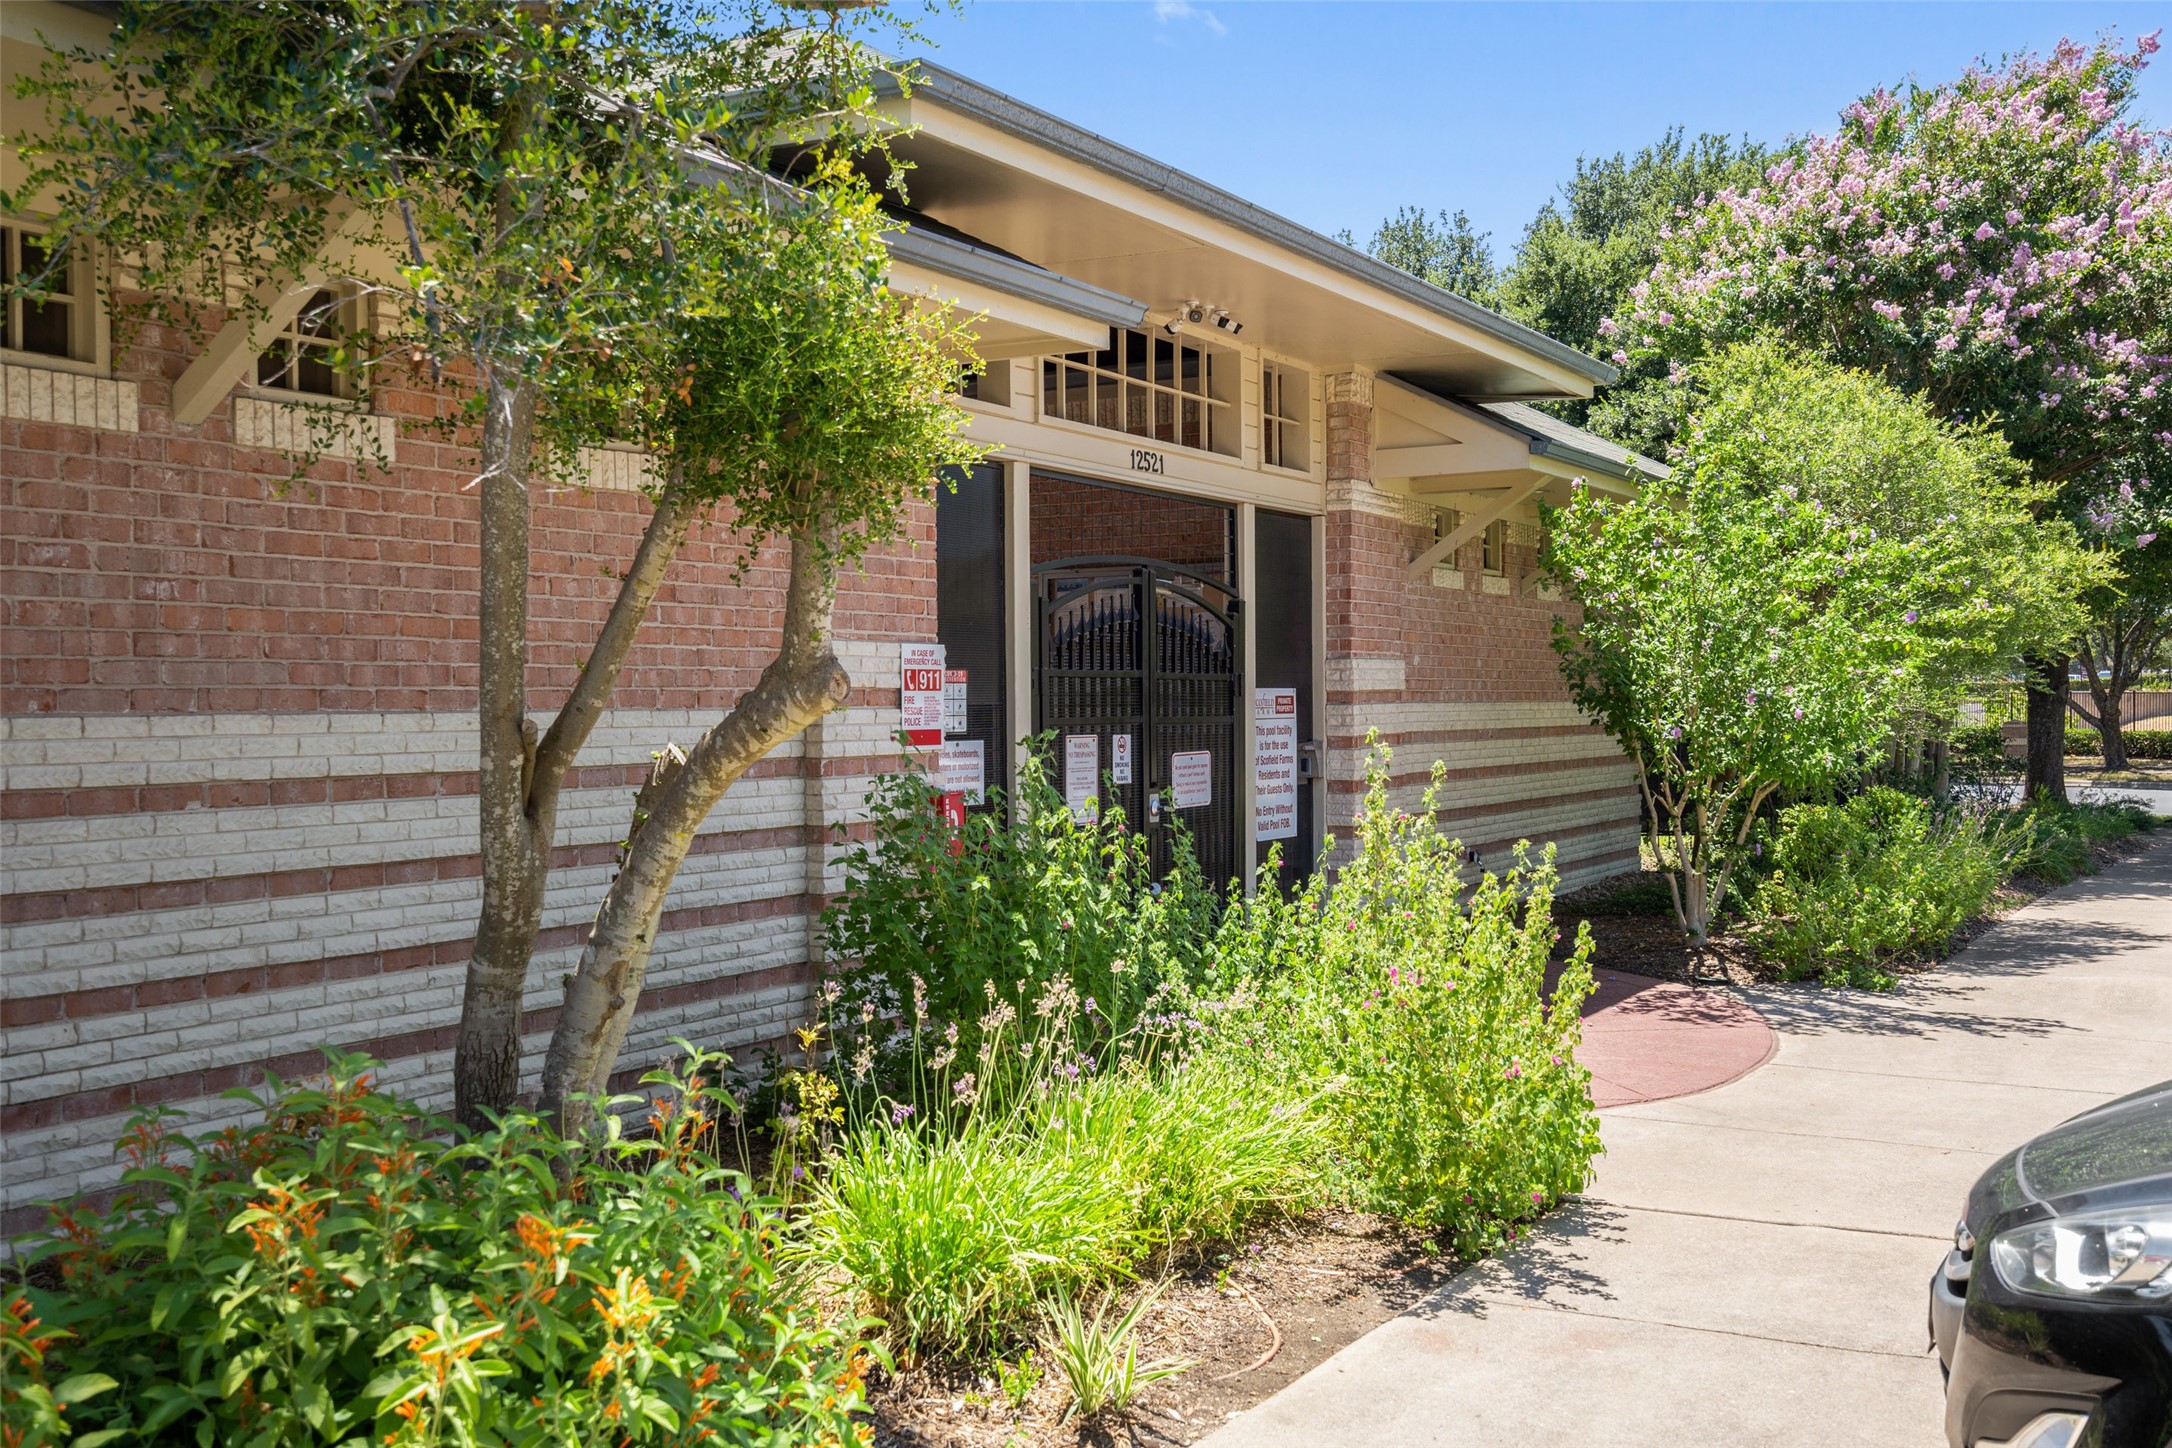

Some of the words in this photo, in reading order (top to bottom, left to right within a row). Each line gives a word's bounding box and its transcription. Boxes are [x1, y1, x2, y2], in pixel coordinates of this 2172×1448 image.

[1130, 449, 1164, 474] 12521
[904, 658, 930, 666] EMERGENCY
[920, 671, 940, 690] 911
[904, 696, 914, 704] FIRE
[904, 706, 922, 715] RESCUE
[904, 718, 920, 726] POLICE
[1256, 726, 1265, 736] This
[1266, 726, 1276, 737] pool
[1276, 725, 1292, 736] facility
[1280, 742, 1288, 750] use
[952, 750, 980, 758] skateboards,
[1260, 754, 1278, 766] Scofield
[1280, 754, 1294, 764] Farms
[958, 762, 980, 770] motorized
[963, 774, 980, 782] allowed
[1259, 770, 1280, 780] Residents
[1281, 768, 1290, 778] and
[1267, 784, 1282, 794] Guests
[1283, 783, 1294, 794] Only.
[1263, 806, 1274, 817] Entry
[1276, 804, 1292, 814] Without
[1258, 820, 1269, 831] Valid
[1270, 820, 1280, 830] Pool
